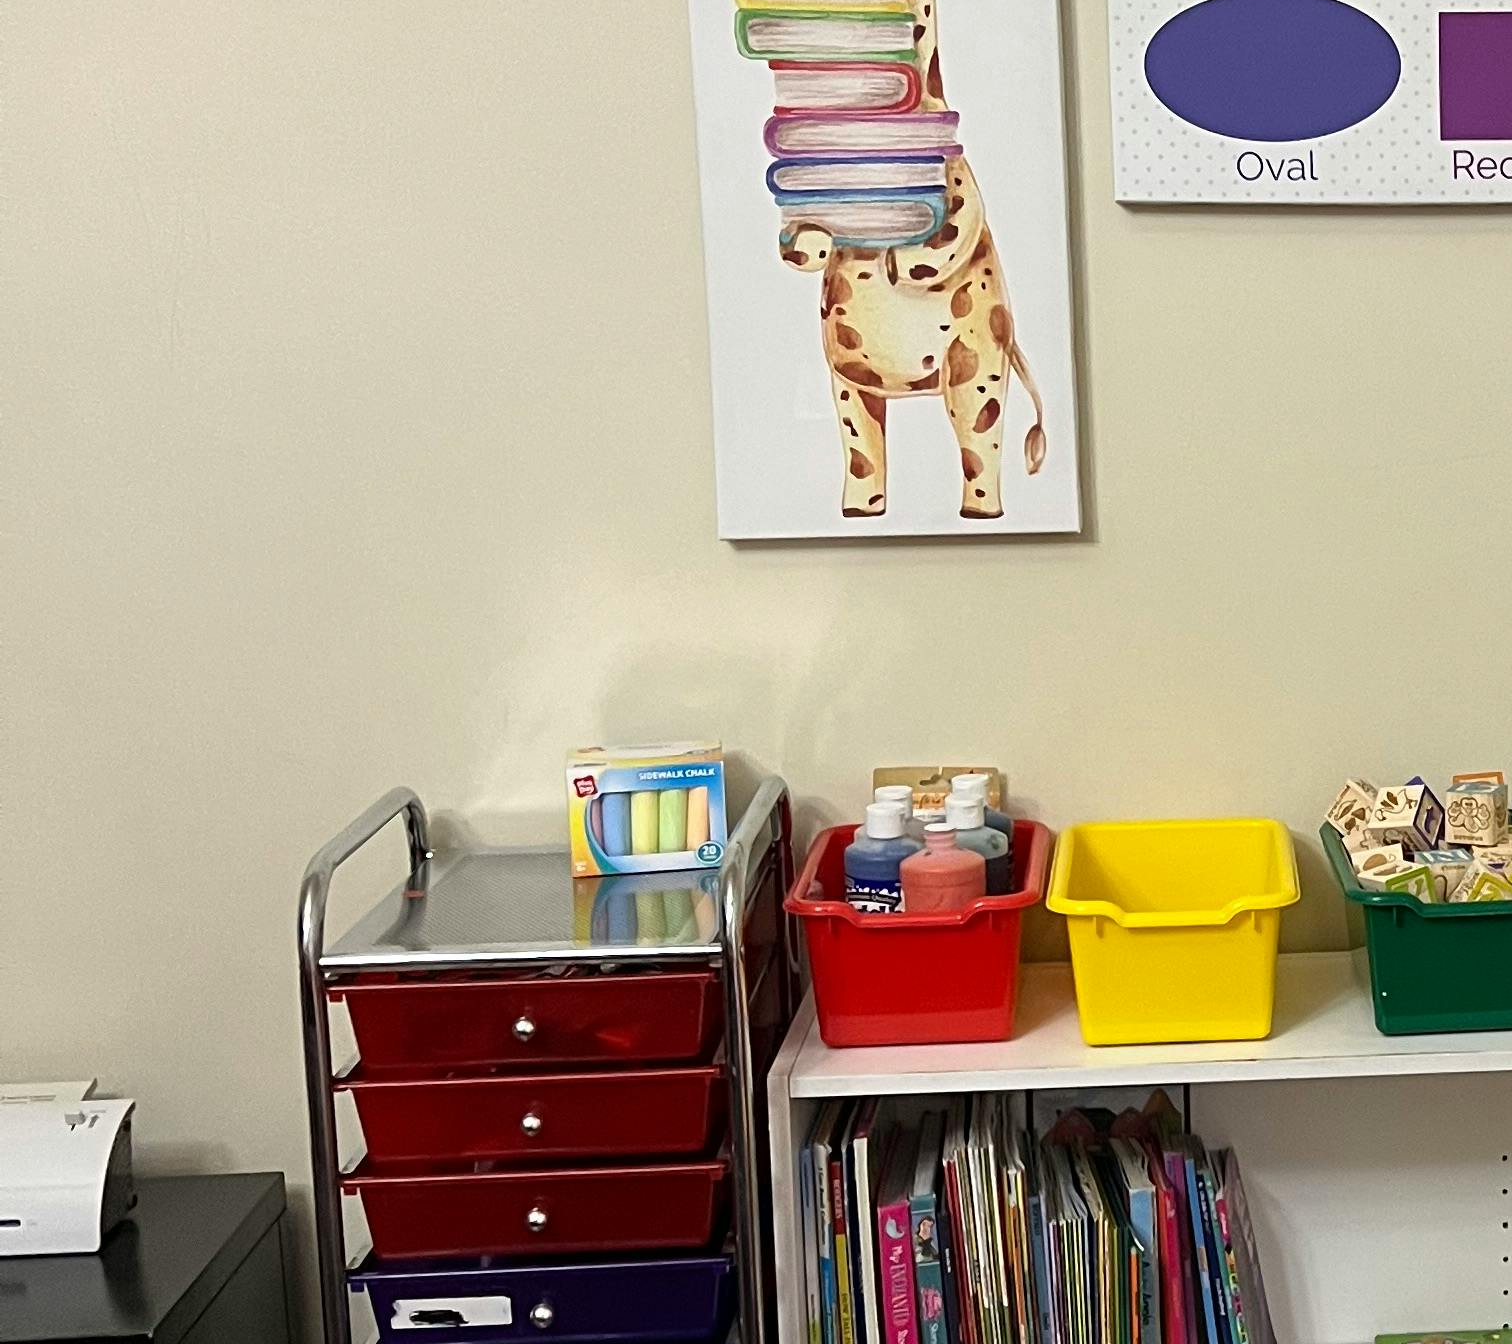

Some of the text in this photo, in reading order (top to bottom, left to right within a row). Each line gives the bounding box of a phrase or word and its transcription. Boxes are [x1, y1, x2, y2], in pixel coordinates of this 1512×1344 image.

[1236, 150, 1319, 182] Oval
[639, 768, 716, 781] SIDEWALK CHALK
[702, 845, 717, 855] 20
